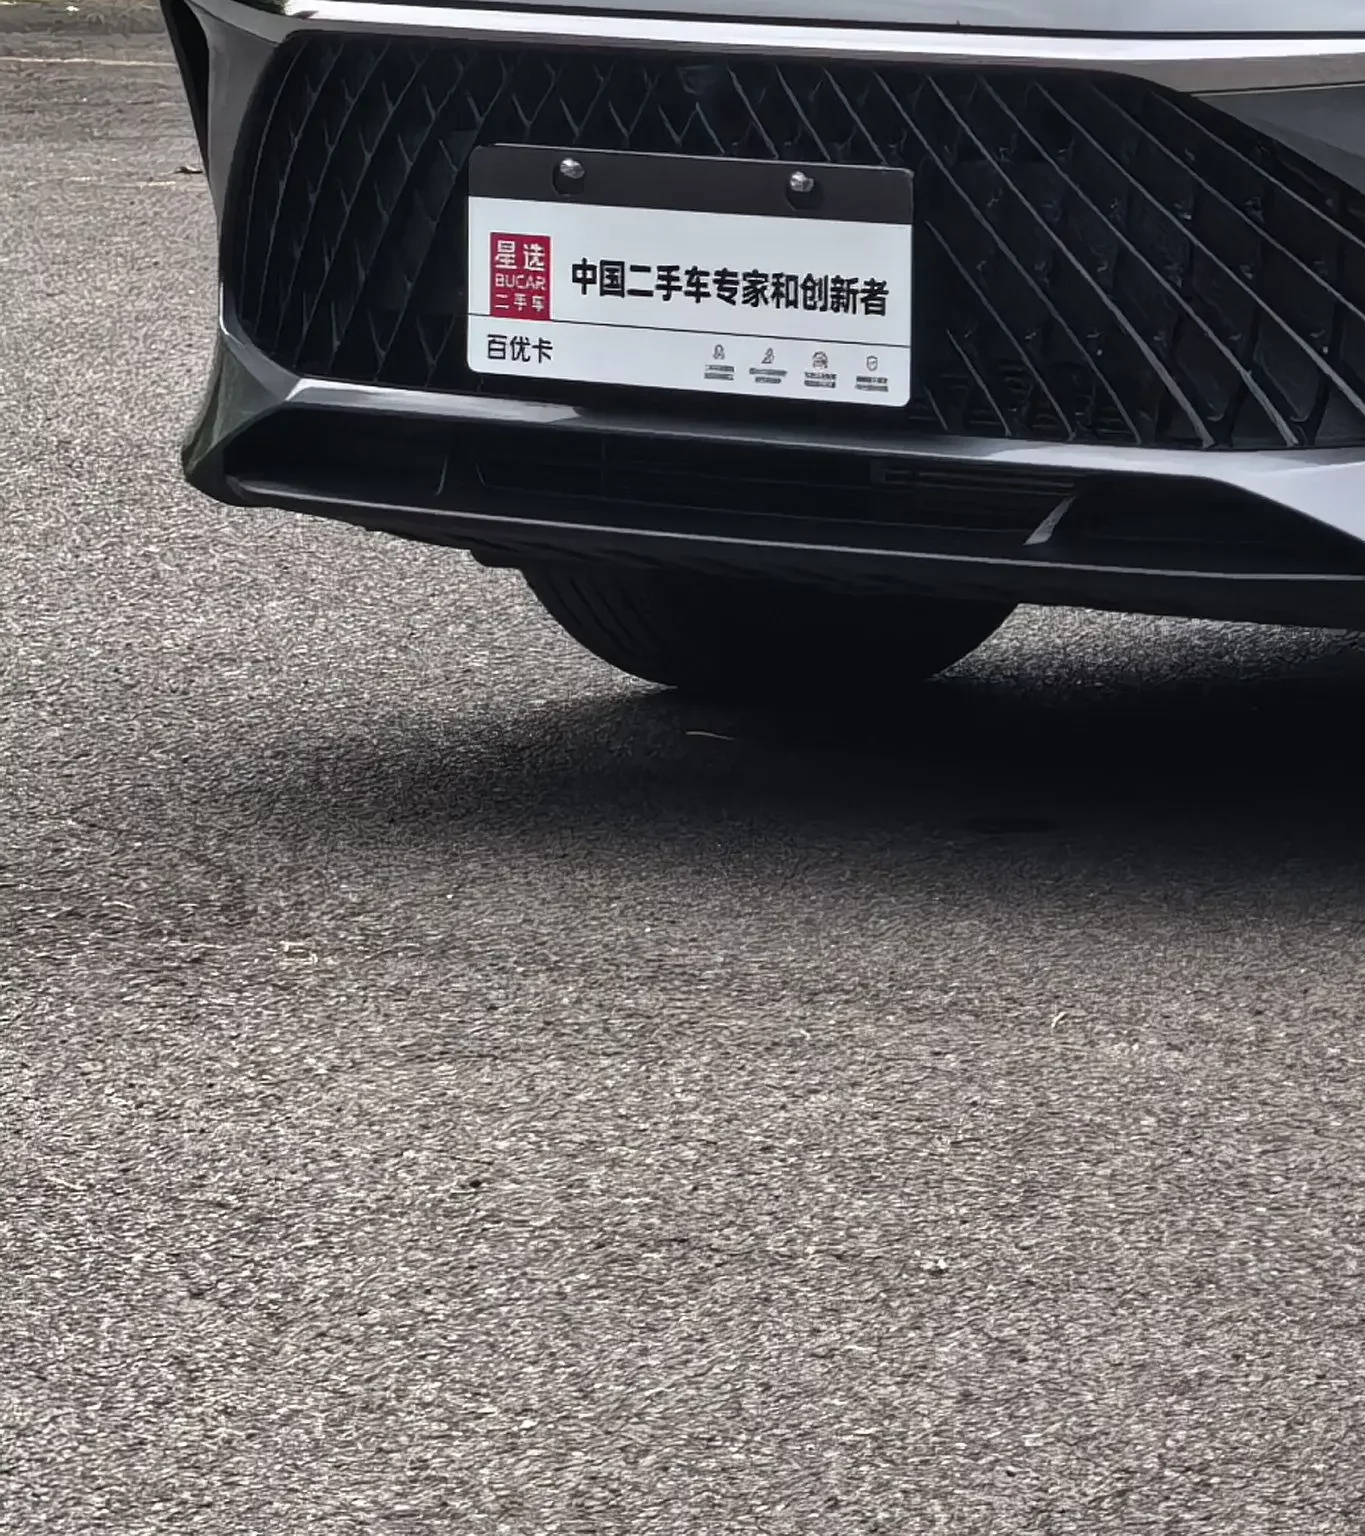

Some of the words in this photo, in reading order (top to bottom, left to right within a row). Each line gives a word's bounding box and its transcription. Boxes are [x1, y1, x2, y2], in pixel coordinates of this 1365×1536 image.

[495, 239, 545, 272] 星选
[495, 272, 546, 291] BUCAR
[571, 257, 889, 317] 中国二手车专家和创新者
[494, 292, 546, 313] 二手车
[486, 333, 553, 364] 百优卡
